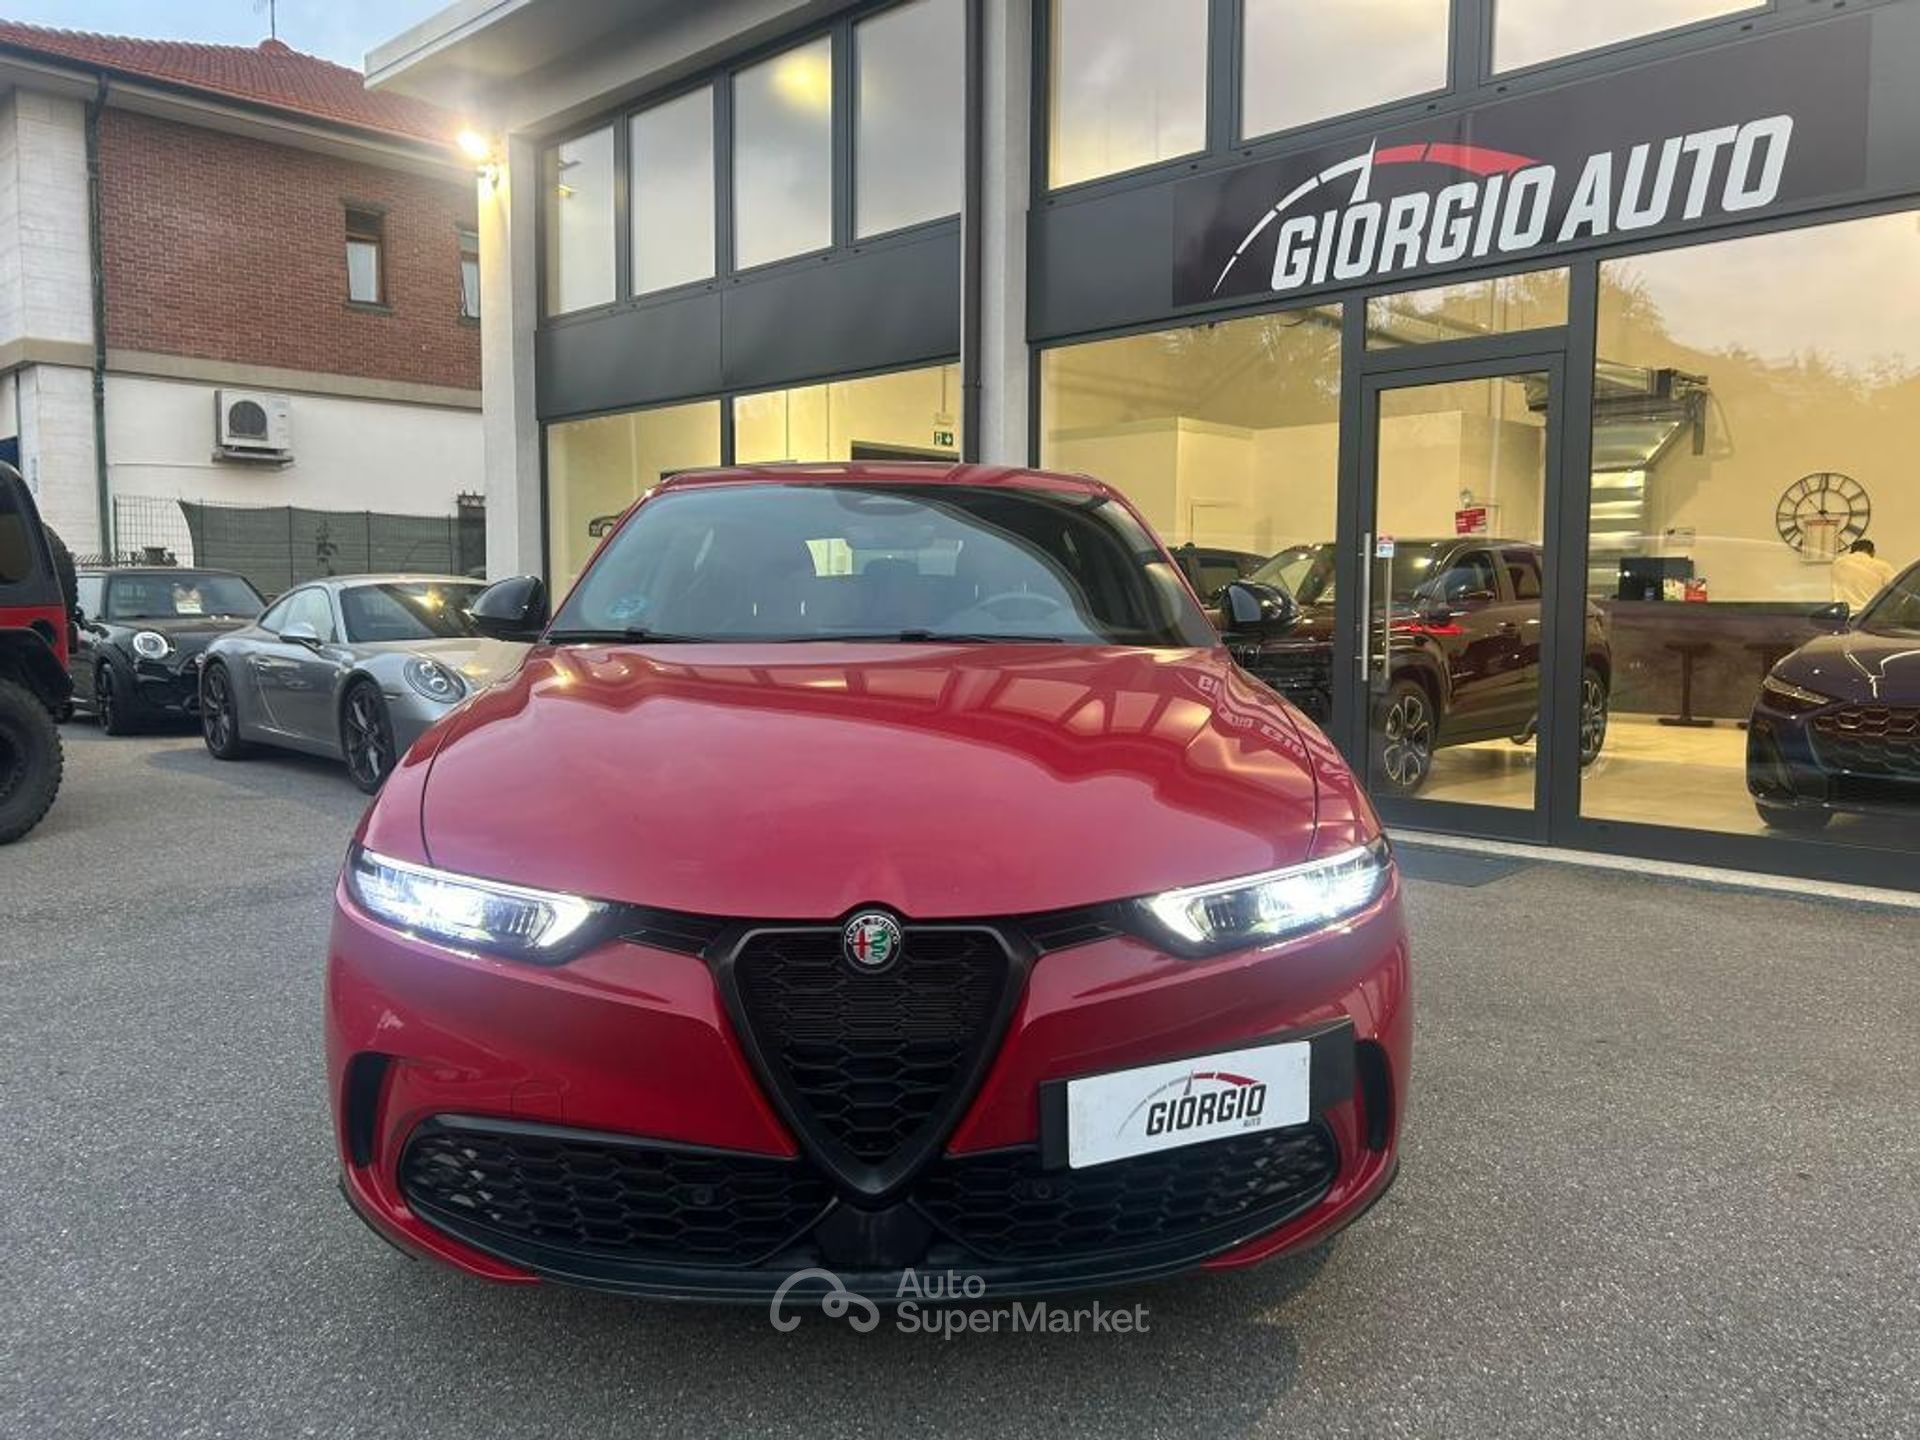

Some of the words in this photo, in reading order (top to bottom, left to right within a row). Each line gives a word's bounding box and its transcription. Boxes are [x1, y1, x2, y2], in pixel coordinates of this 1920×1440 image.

[1271, 165, 1556, 291] GIORGIO
[1557, 114, 1794, 243] AUTO
[1146, 1084, 1267, 1136] GIORGIO
